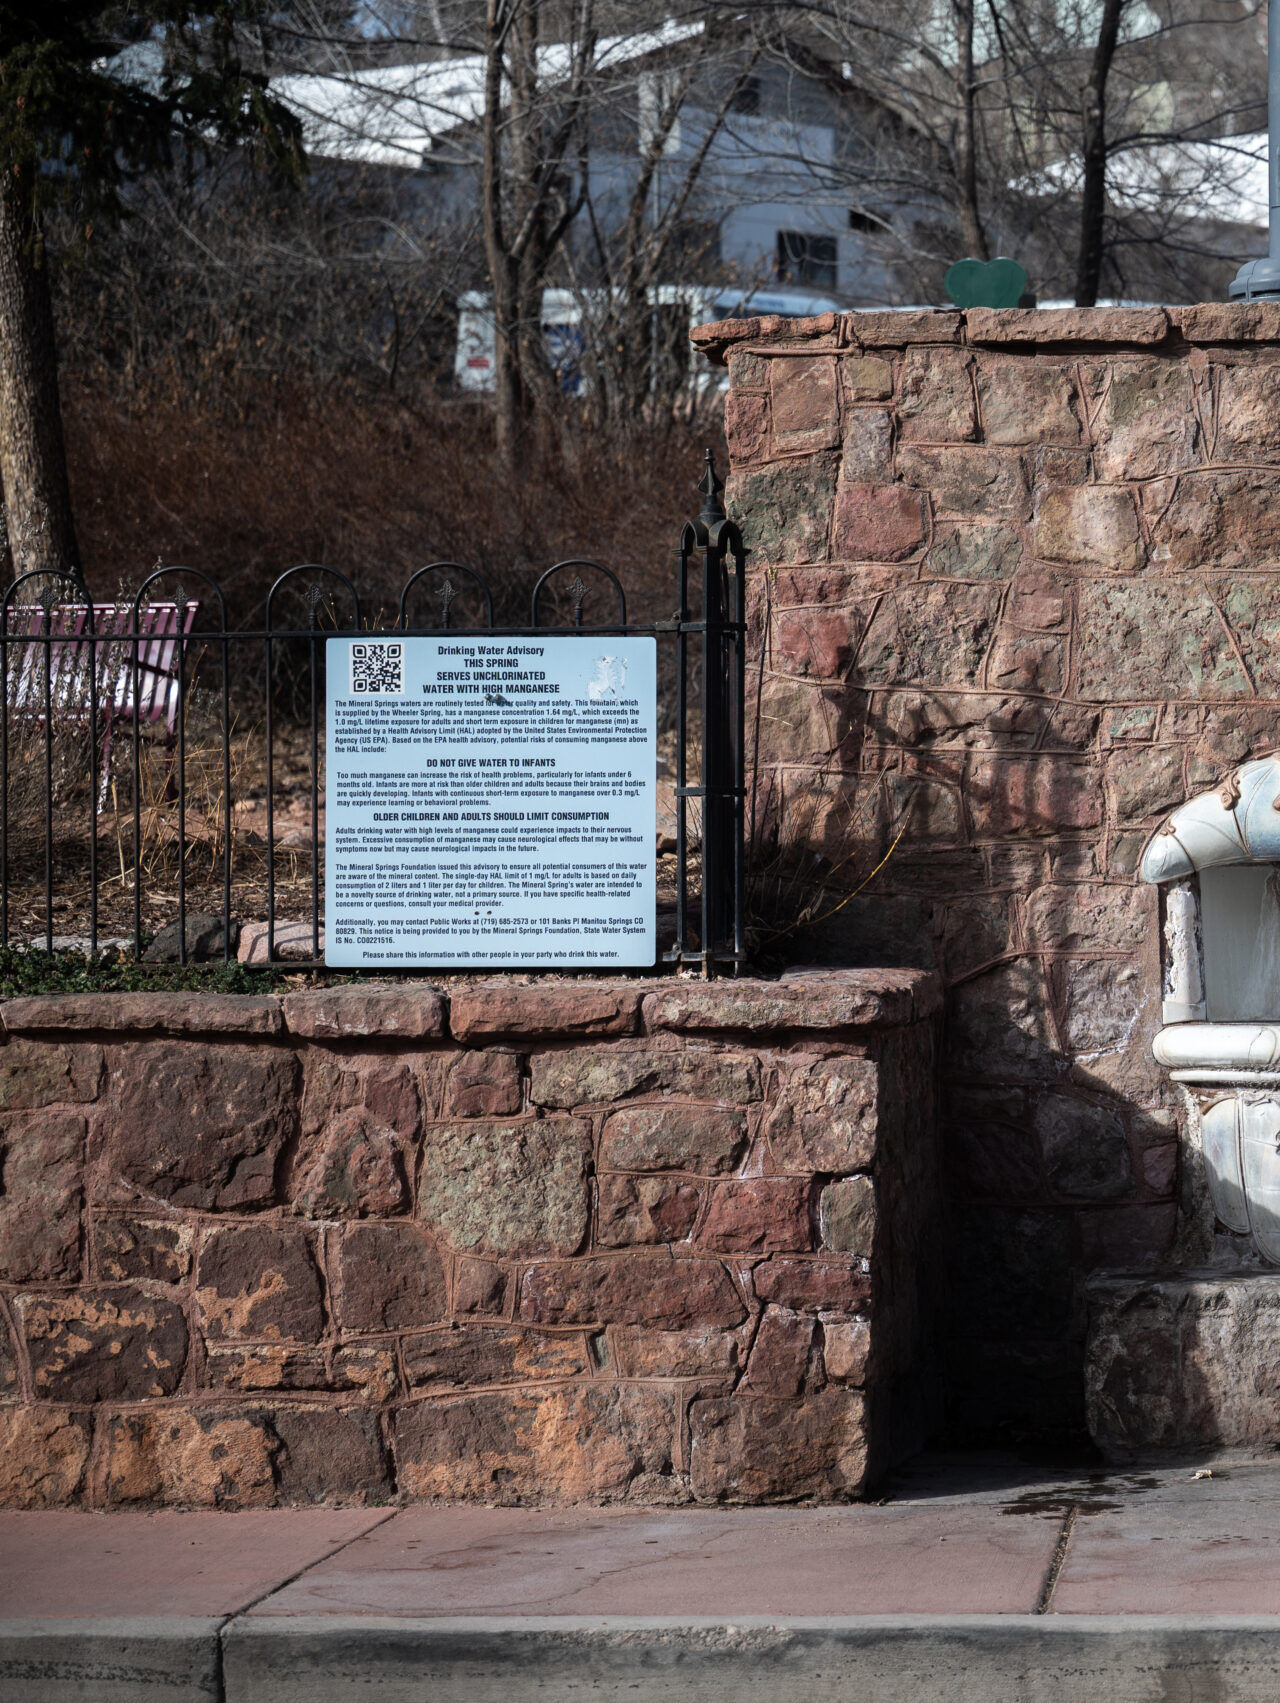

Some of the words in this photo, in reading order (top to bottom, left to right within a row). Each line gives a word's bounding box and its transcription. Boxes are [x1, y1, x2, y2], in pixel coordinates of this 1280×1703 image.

[438, 646, 475, 657] Drinking
[478, 646, 504, 655] Water
[507, 646, 544, 657] Advisory
[464, 659, 484, 667] THIS
[486, 659, 518, 667] SPRING
[437, 672, 470, 681] SERVES
[473, 671, 545, 680] UNCHLORINATED
[423, 685, 454, 693] WATER
[456, 684, 479, 693] WITH
[482, 684, 503, 693] HIGH
[506, 684, 560, 693] MANGANESE
[342, 709, 369, 718] supplied
[335, 737, 358, 745] Agency
[360, 737, 371, 745] (US
[470, 736, 498, 745] advisory,
[501, 736, 528, 745] potential
[555, 736, 589, 744] consuming
[427, 759, 437, 767] DO
[440, 759, 456, 767] NOT
[458, 759, 476, 767] GIVE
[479, 759, 507, 767] WATER
[509, 759, 519, 767] TO
[522, 759, 555, 767] INFANTS
[352, 799, 387, 808] experience
[388, 799, 414, 807] learning
[459, 799, 491, 807] problems.
[374, 813, 399, 821] OLDER
[401, 813, 440, 821] CHILDREN
[442, 813, 459, 821] AND
[461, 812, 491, 821] ADULTS
[494, 812, 524, 820] SHOULD
[527, 812, 549, 820] LIMIT
[552, 812, 609, 820] CONSUMPTION
[481, 918, 497, 926] (719)
[609, 918, 633, 926] Springs
[490, 951, 511, 959] people
[536, 951, 552, 959] party
